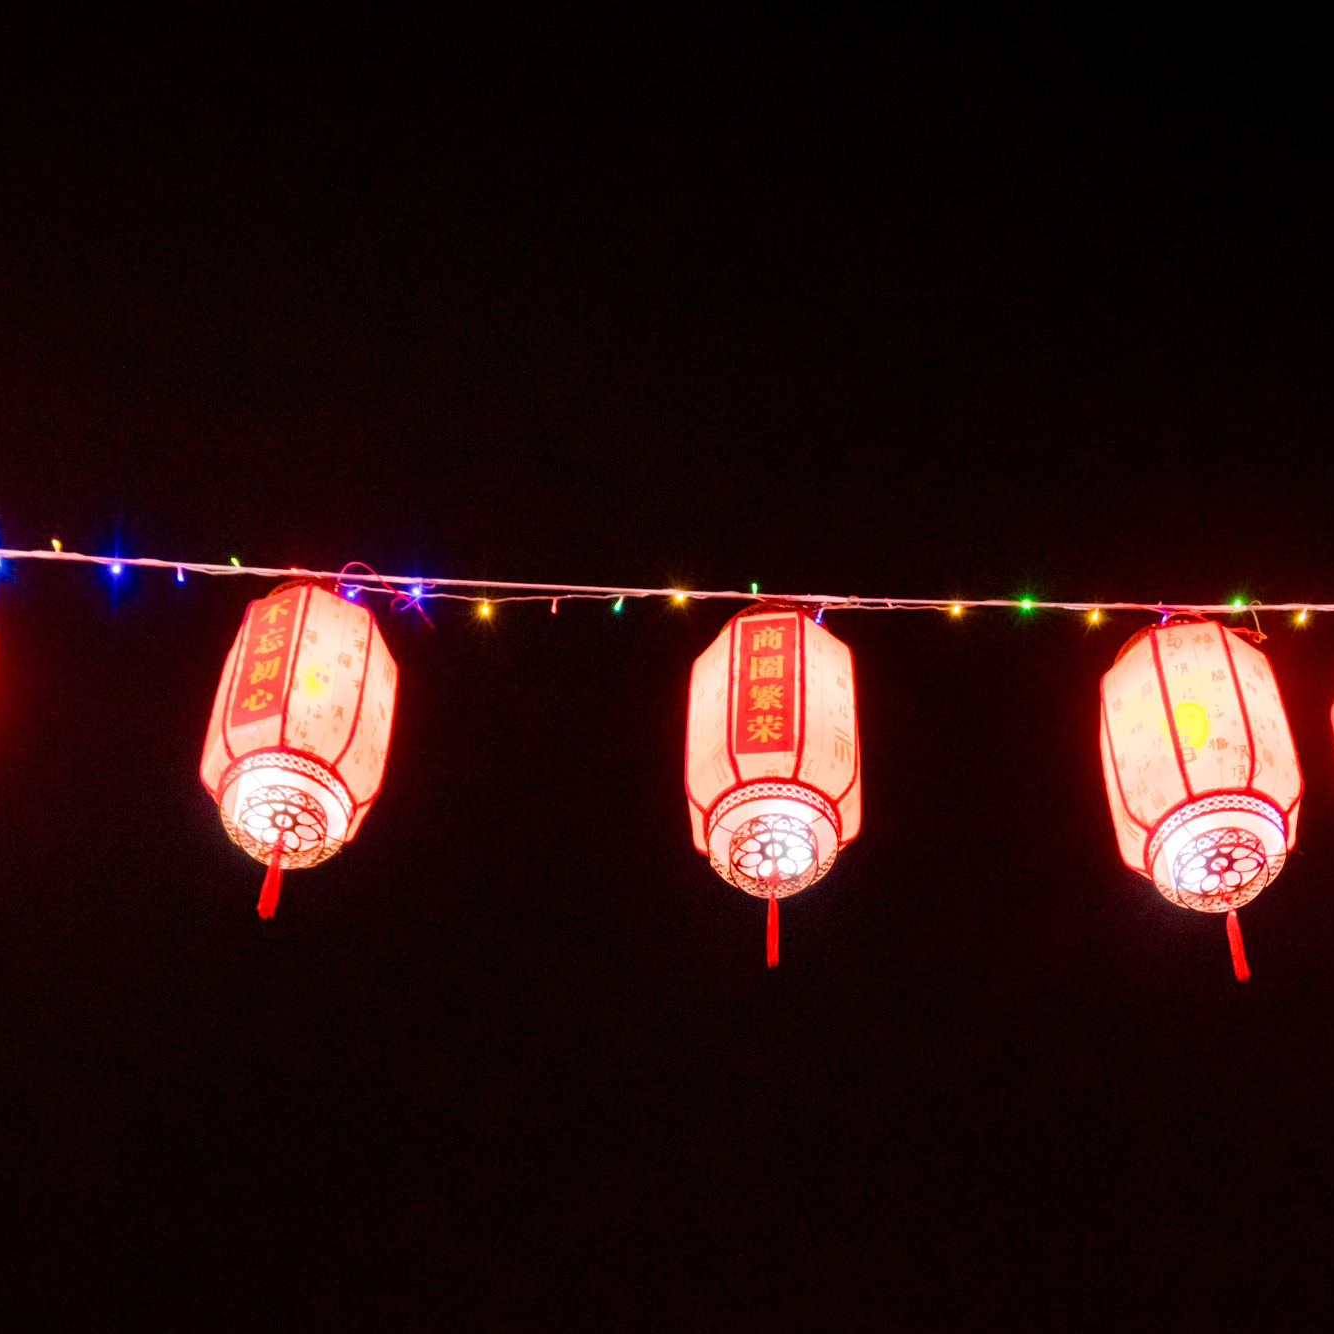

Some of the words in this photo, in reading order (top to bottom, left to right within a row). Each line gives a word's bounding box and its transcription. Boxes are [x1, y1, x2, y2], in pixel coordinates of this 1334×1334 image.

[240, 598, 292, 712] 不忘初心
[746, 626, 786, 743] 商圈繁荣
